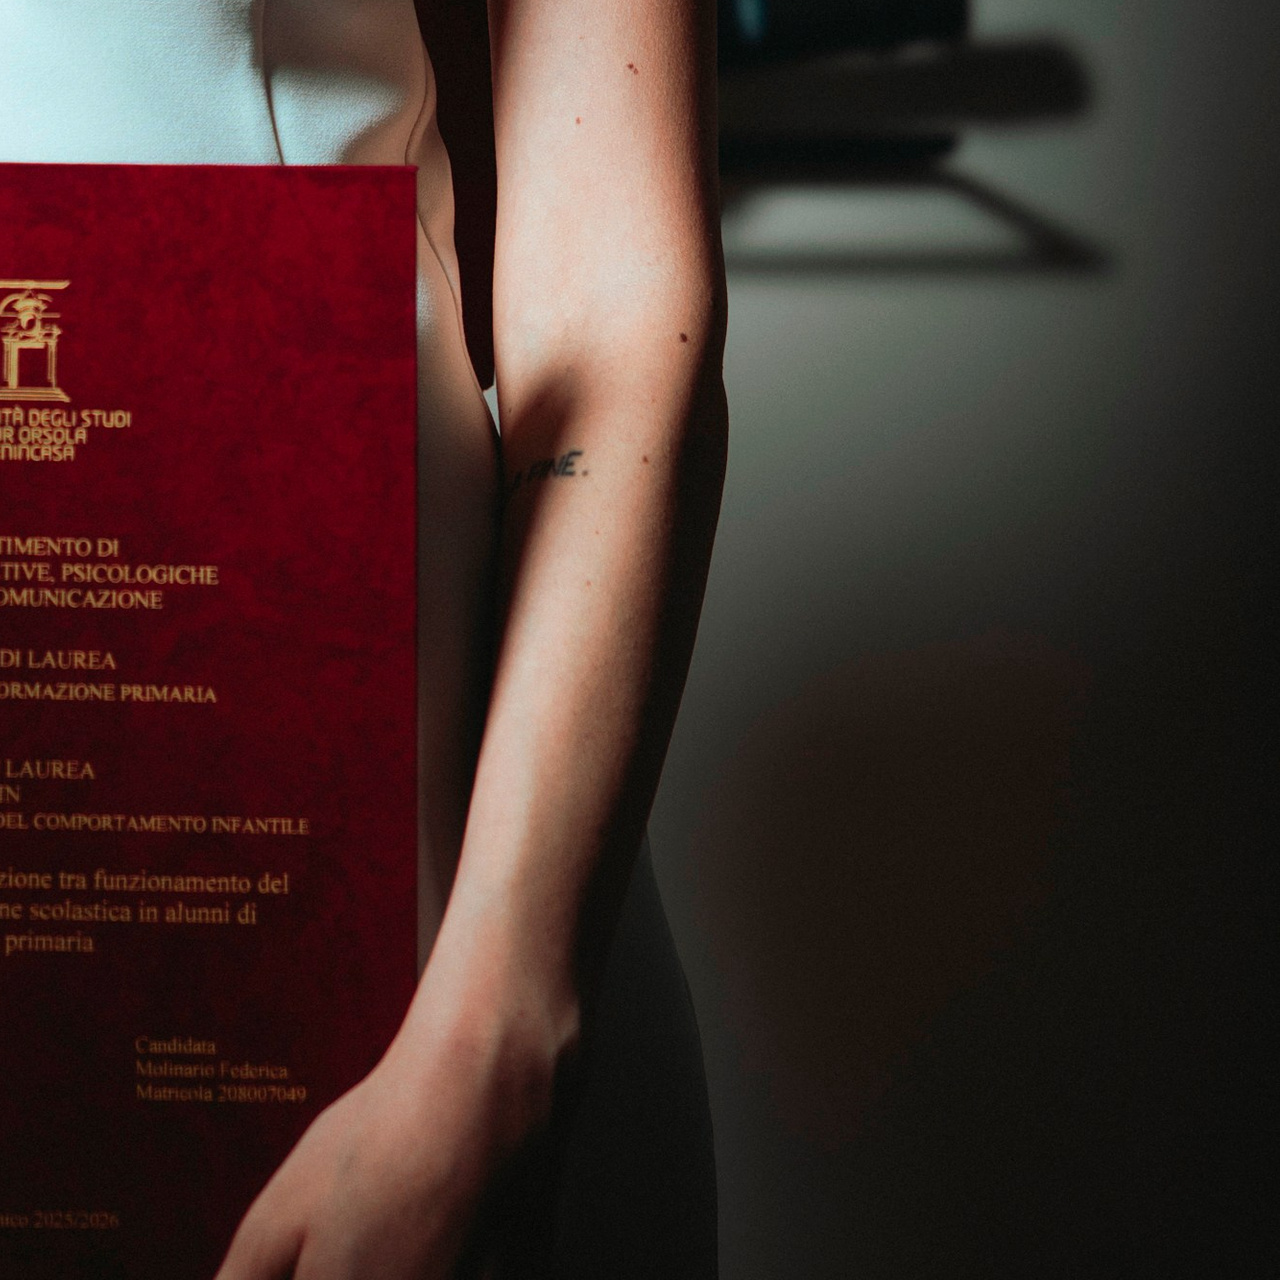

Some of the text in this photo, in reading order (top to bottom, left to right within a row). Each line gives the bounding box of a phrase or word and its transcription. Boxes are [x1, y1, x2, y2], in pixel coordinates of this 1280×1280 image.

[30, 410, 77, 427] DEGLI
[82, 410, 132, 428] STUDI
[20, 427, 87, 444] ORSOLA
[97, 538, 119, 557] DI
[63, 564, 218, 585] PSICOLOGICHE
[0, 649, 21, 667] DI
[28, 650, 116, 669] LAUREA
[121, 684, 217, 702] PRIMARIA
[6, 759, 95, 779] LAUREA
[33, 813, 207, 832] COMPORTAMENTO
[212, 817, 308, 834] INFANTILE
[59, 870, 87, 889] tra
[94, 869, 251, 892] funzionamento
[258, 872, 288, 894] del
[30, 900, 131, 922] scolastica
[139, 902, 158, 922] in
[165, 902, 229, 923] alunni
[237, 903, 256, 924] di
[5, 932, 94, 956] primaria
[135, 1036, 216, 1054] Candidata
[220, 1062, 288, 1079] Federica
[136, 1084, 213, 1101] Matricola
